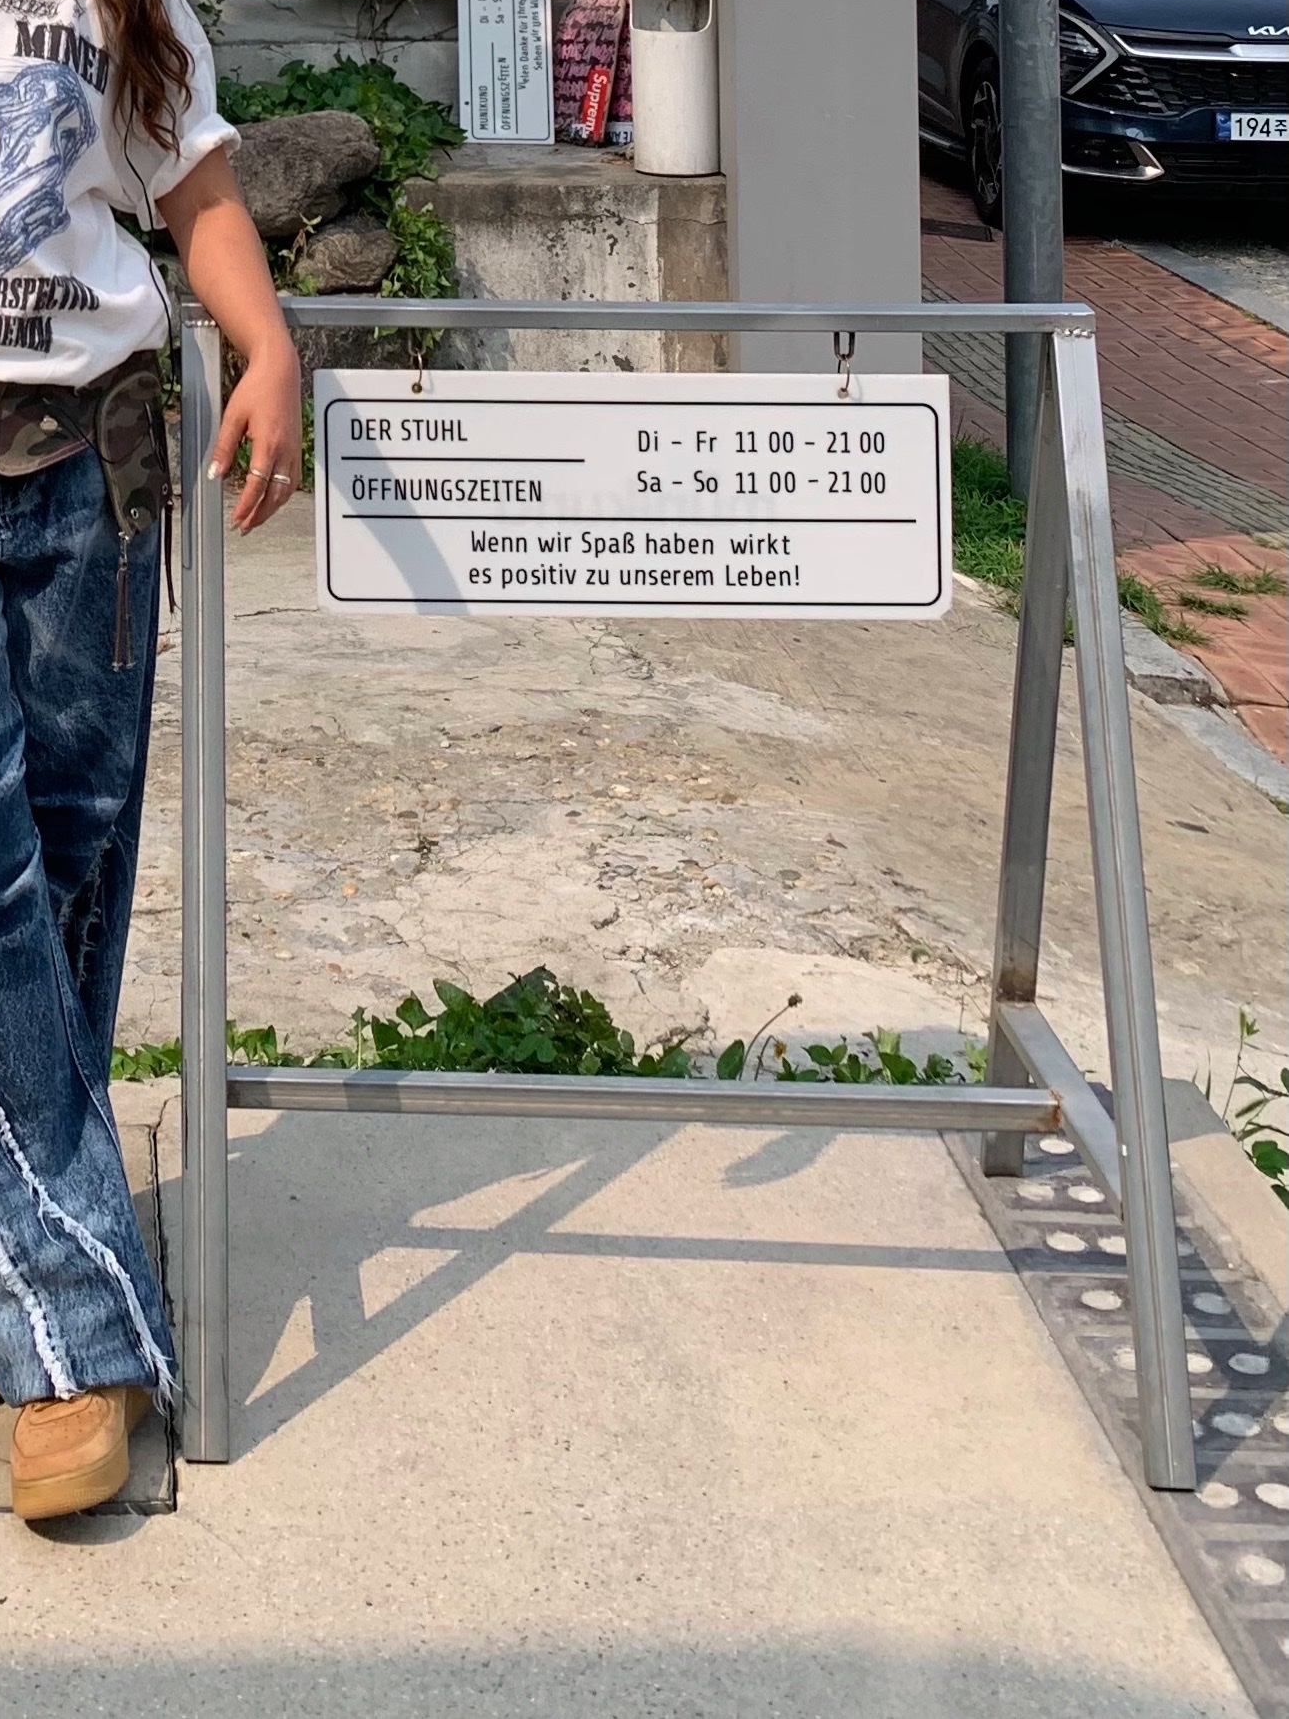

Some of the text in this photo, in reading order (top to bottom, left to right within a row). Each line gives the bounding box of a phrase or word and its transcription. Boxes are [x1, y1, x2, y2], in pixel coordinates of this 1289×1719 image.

[519, 36, 529, 62] Danke
[533, 45, 543, 71] Sehen
[582, 73, 608, 137] Suprem
[1234, 117, 1288, 138] 194주
[350, 418, 468, 442] DER STUHL
[637, 430, 659, 453] Di
[696, 431, 717, 453] Fr
[735, 431, 758, 453] 11
[768, 431, 794, 454] 00
[826, 431, 851, 454] 21
[859, 431, 885, 454] 00
[352, 474, 542, 503] ÖFFNUNGSZEITEN
[637, 470, 662, 493] Sa
[693, 470, 719, 493] So
[735, 471, 758, 494] 11
[769, 471, 796, 493] 00
[828, 470, 852, 493] 21
[860, 471, 886, 494] 00
[470, 530, 791, 558] Wenn wir Spaß haben wirkt
[468, 563, 800, 589] es positiv zu unserem Leben!
